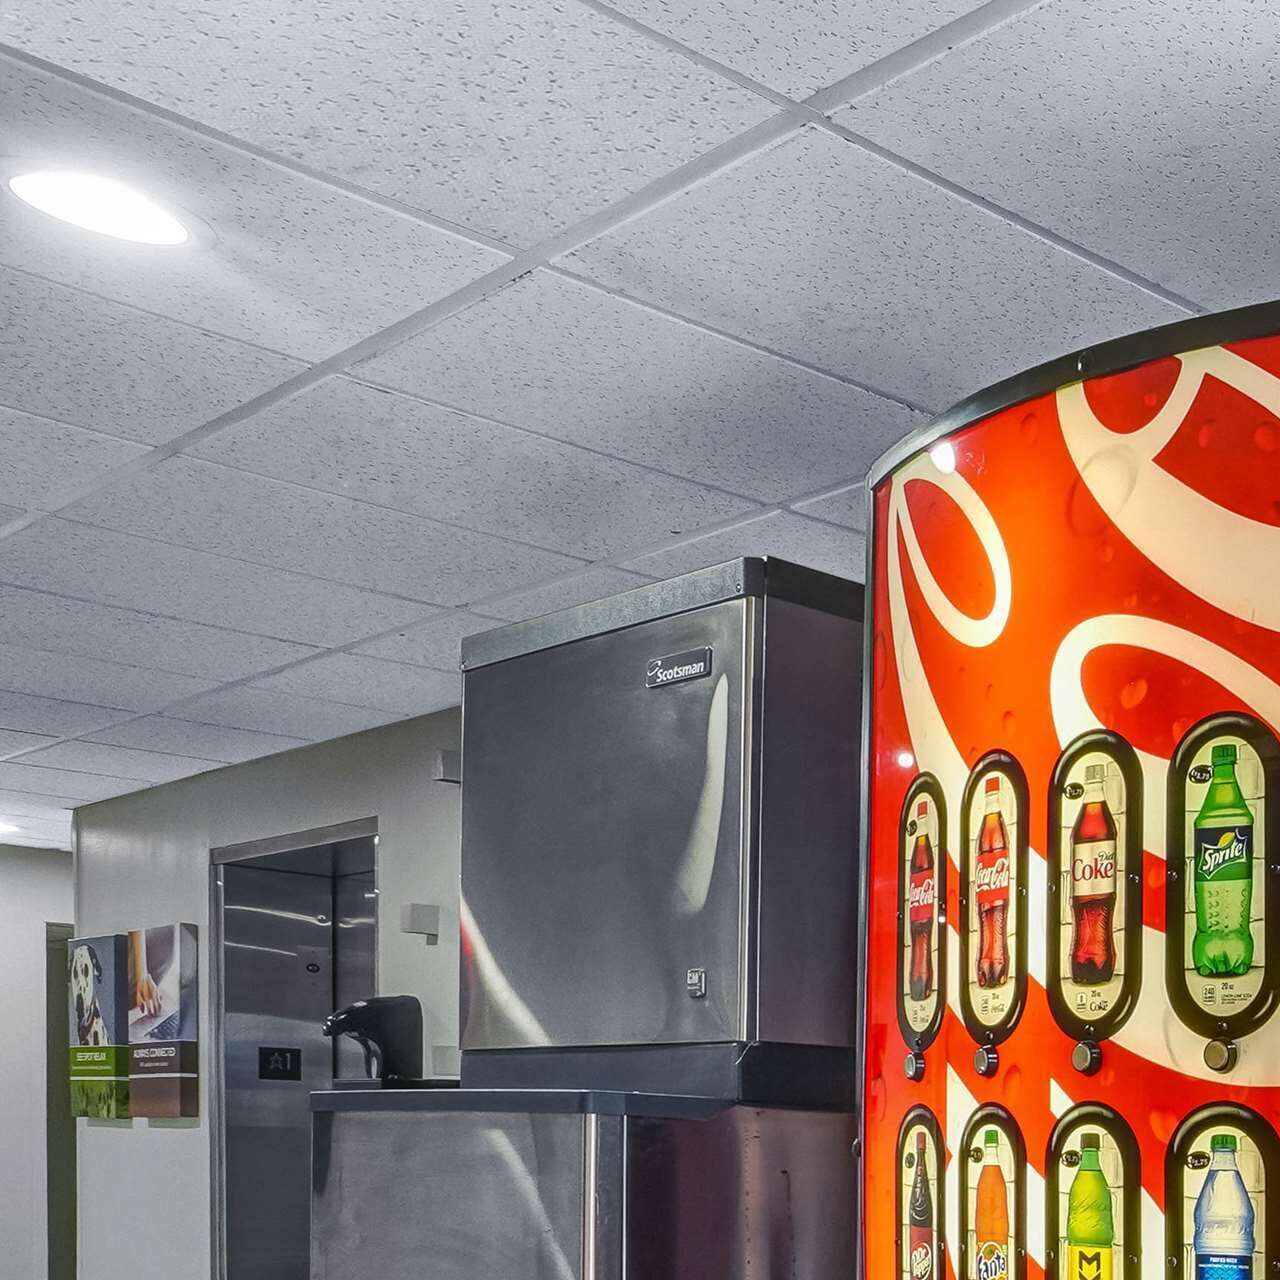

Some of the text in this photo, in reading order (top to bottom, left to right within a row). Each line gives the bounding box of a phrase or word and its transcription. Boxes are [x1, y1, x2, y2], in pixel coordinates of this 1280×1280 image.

[656, 662, 704, 682] Scotsman
[1203, 840, 1244, 871] Sprite
[1072, 858, 1114, 883] Coke
